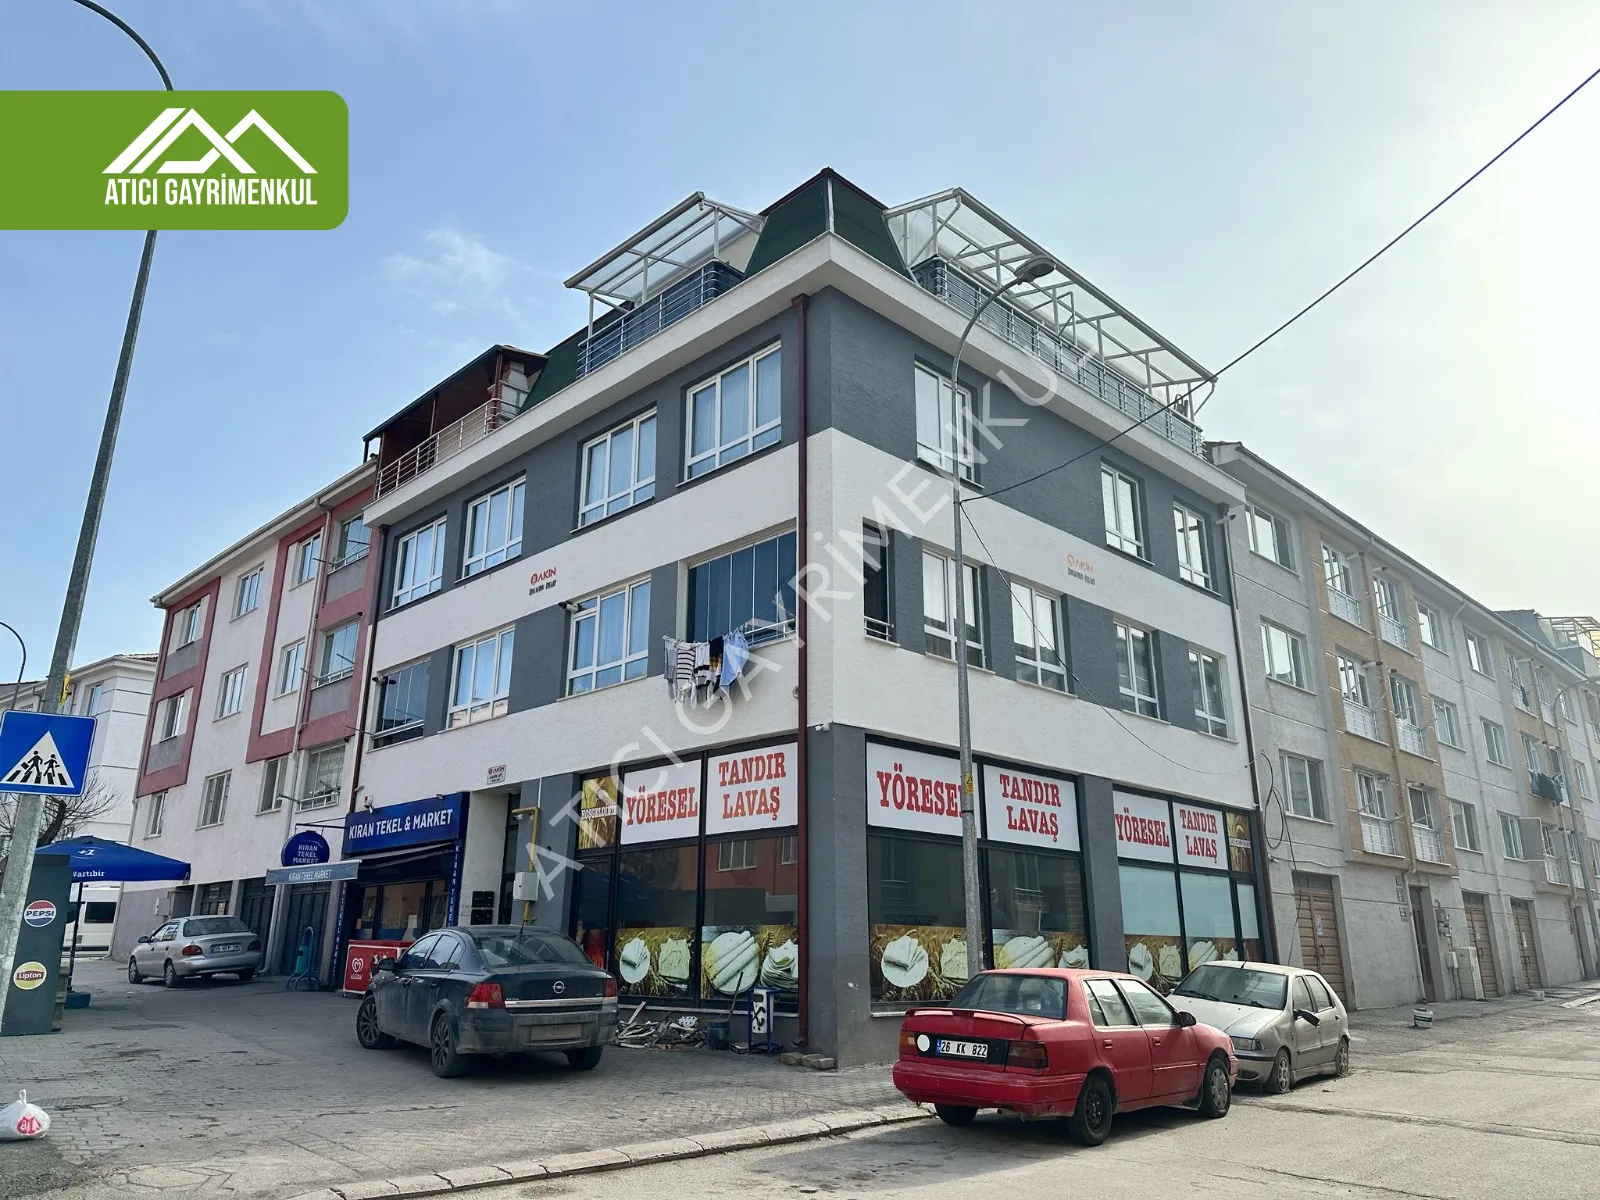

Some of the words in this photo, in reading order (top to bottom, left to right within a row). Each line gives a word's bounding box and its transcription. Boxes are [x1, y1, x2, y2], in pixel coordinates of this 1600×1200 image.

[719, 752, 786, 787] TANDIR
[626, 785, 698, 826] YÖRESEL
[722, 786, 781, 821] LAVAŞ
[877, 762, 964, 818] YÖRESE
[1000, 773, 1062, 808] TANDIR
[349, 822, 375, 839] KIRAN
[376, 818, 403, 836] TEKEL
[404, 816, 412, 831] &
[413, 808, 454, 830] MARKET
[1006, 805, 1059, 842] LAVAŞ
[1115, 807, 1170, 848] YÖRESEL
[1179, 809, 1218, 834] TANDIR
[298, 844, 318, 852] KIRAN
[1185, 835, 1218, 864] LAVAŞ
[19, 972, 42, 980] Lipton
[941, 1041, 951, 1053] 26
[956, 1043, 967, 1054] KK
[972, 1045, 988, 1056] 822
